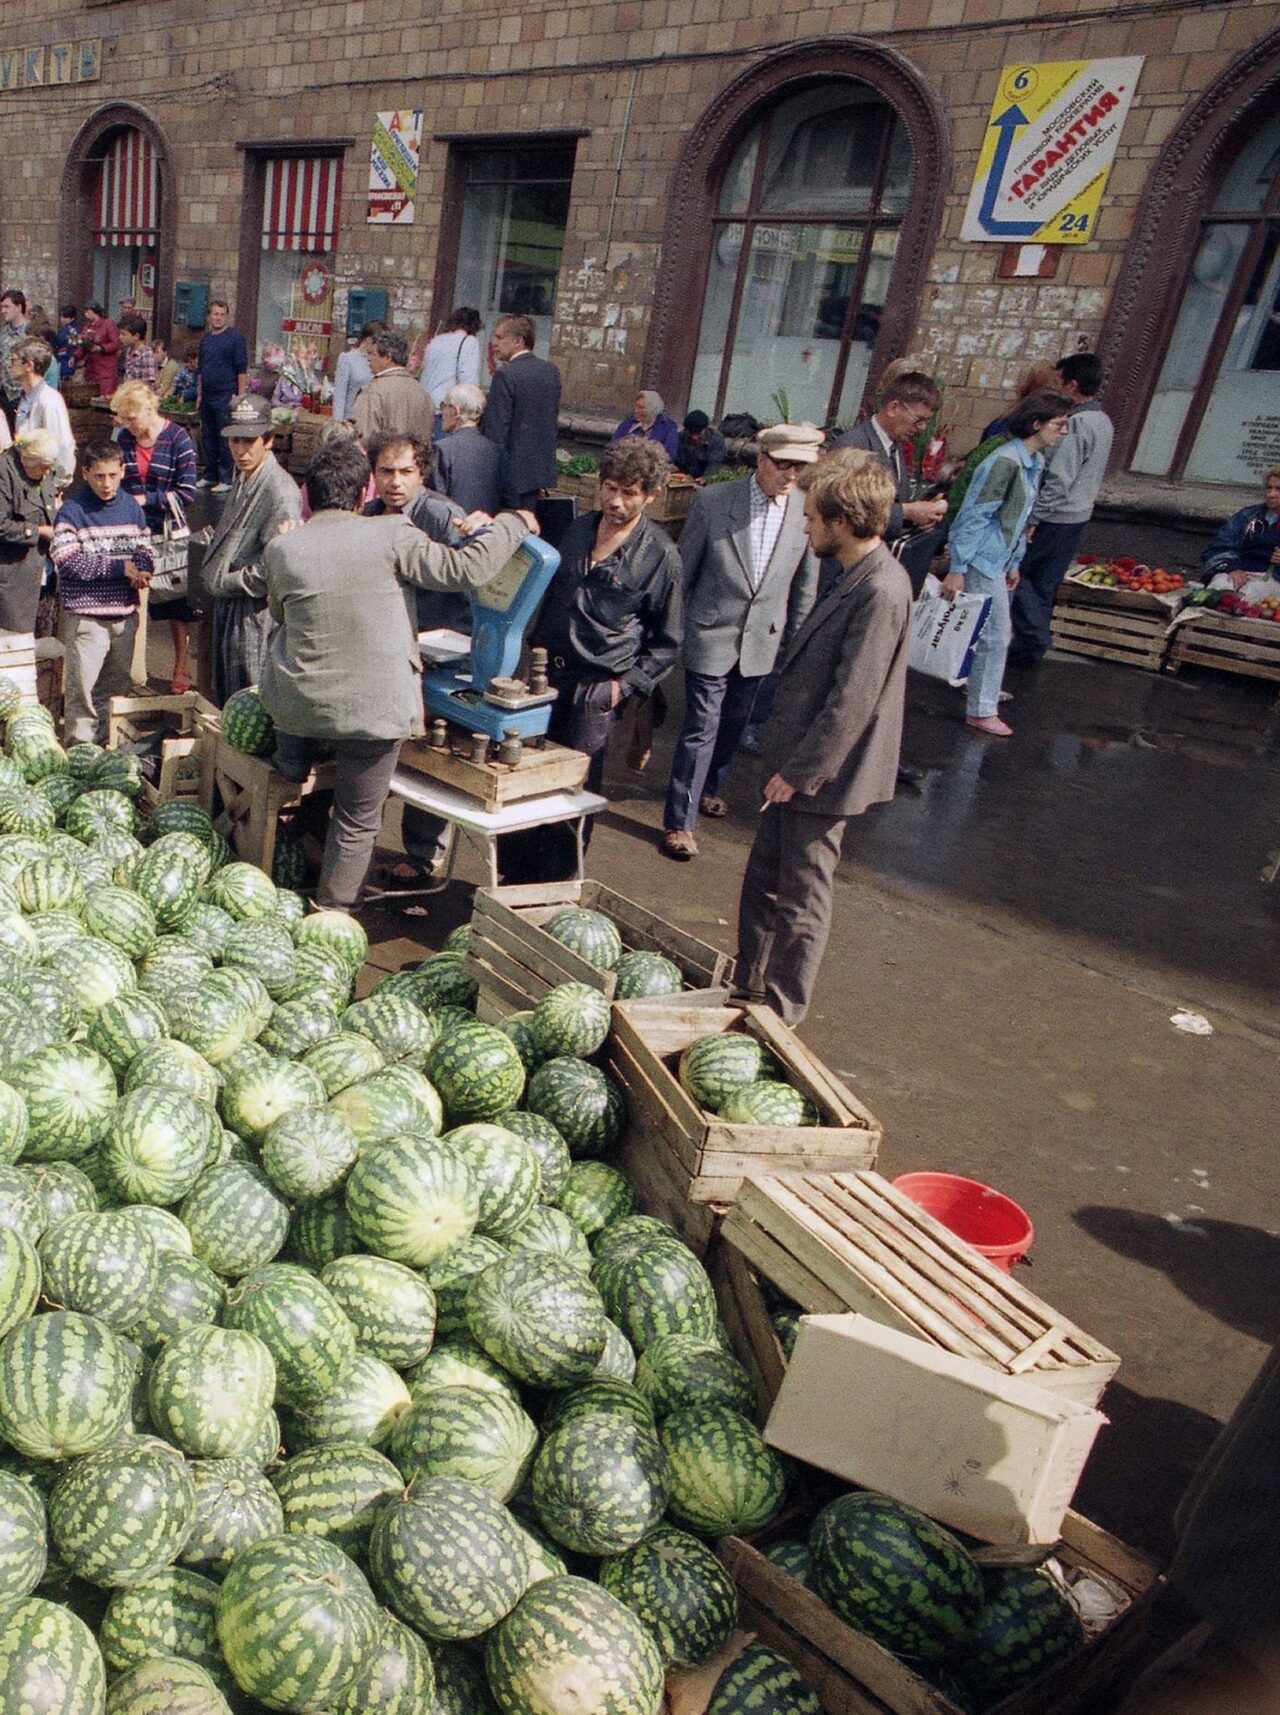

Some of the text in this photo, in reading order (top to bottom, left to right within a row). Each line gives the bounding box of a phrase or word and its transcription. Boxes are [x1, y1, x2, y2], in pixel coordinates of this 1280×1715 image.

[1014, 69, 1030, 90] 6
[1041, 78, 1100, 137] МОСКОВСКИЙ
[1010, 91, 1120, 198] ГАРАНТИЯ
[1013, 83, 1105, 175] ПРАВОВОЙ КООПЕРАТИВ
[1092, 123, 1118, 149] УСЛУГ
[1022, 190, 1039, 206] ВСЕ
[1065, 127, 1104, 167] ДЕЛОВЫХ
[1058, 213, 1089, 232] 24
